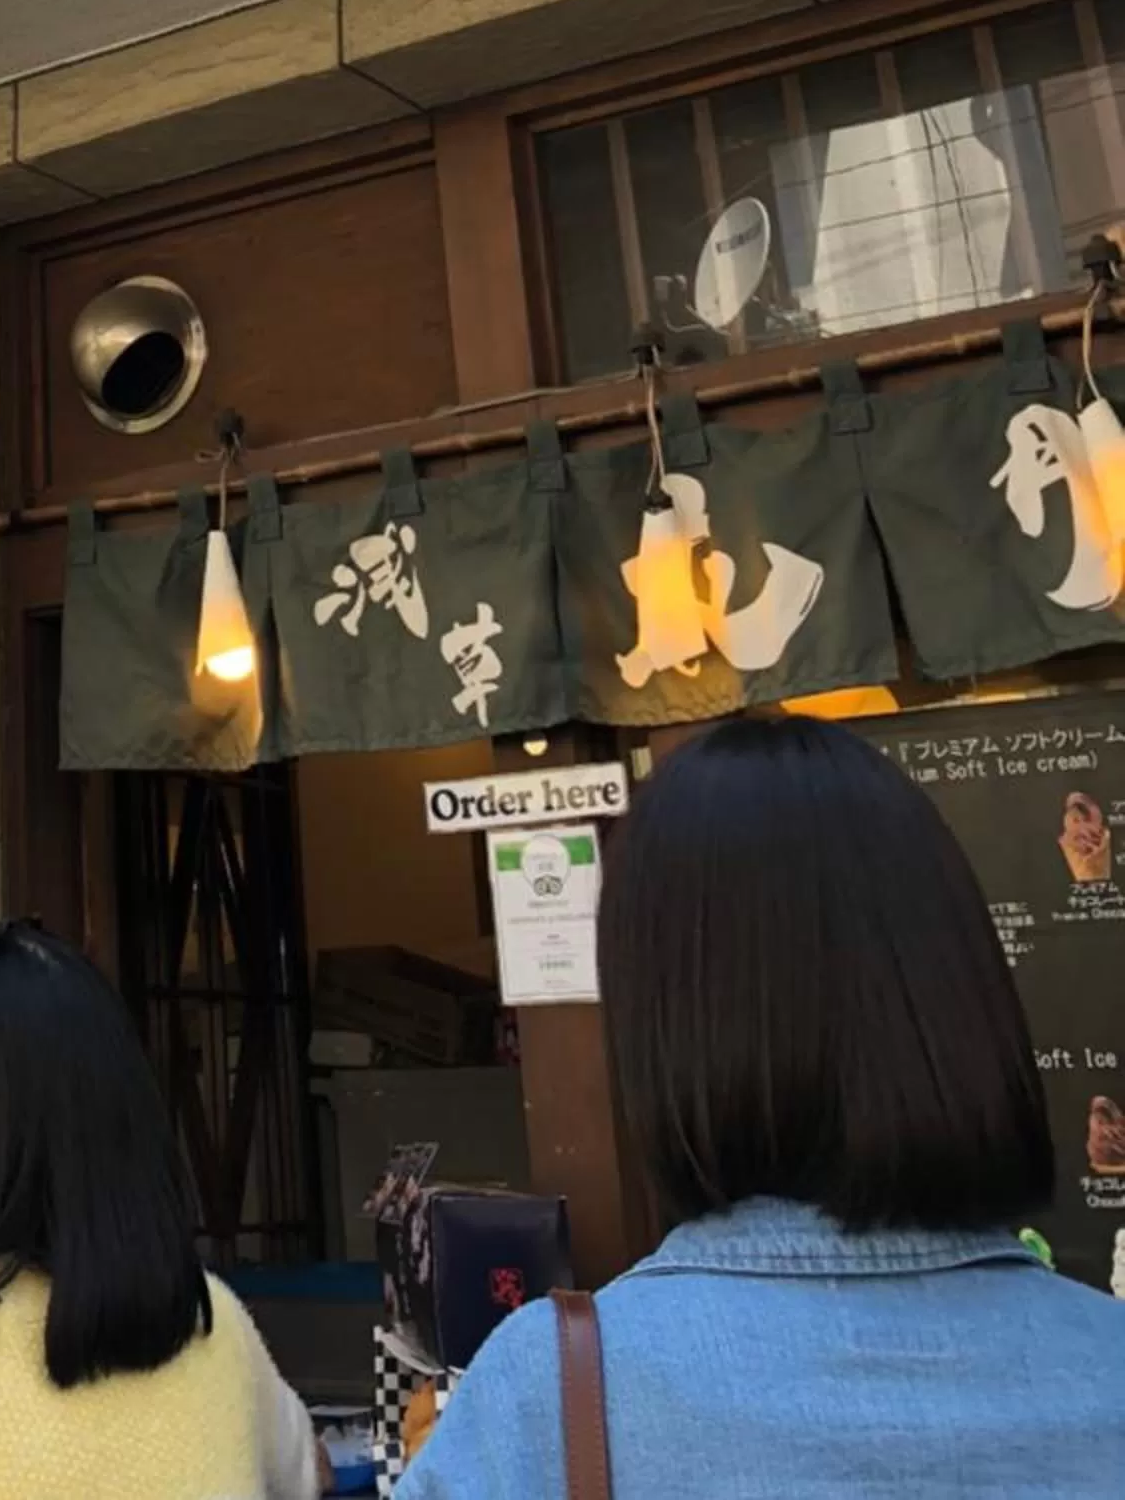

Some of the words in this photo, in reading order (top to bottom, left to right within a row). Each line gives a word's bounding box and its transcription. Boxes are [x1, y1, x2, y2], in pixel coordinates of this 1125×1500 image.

[944, 758, 988, 781] Soft
[997, 756, 1028, 776] Ice
[430, 784, 533, 822] Order
[540, 779, 621, 812] here
[1084, 1047, 1118, 1069] Ice
